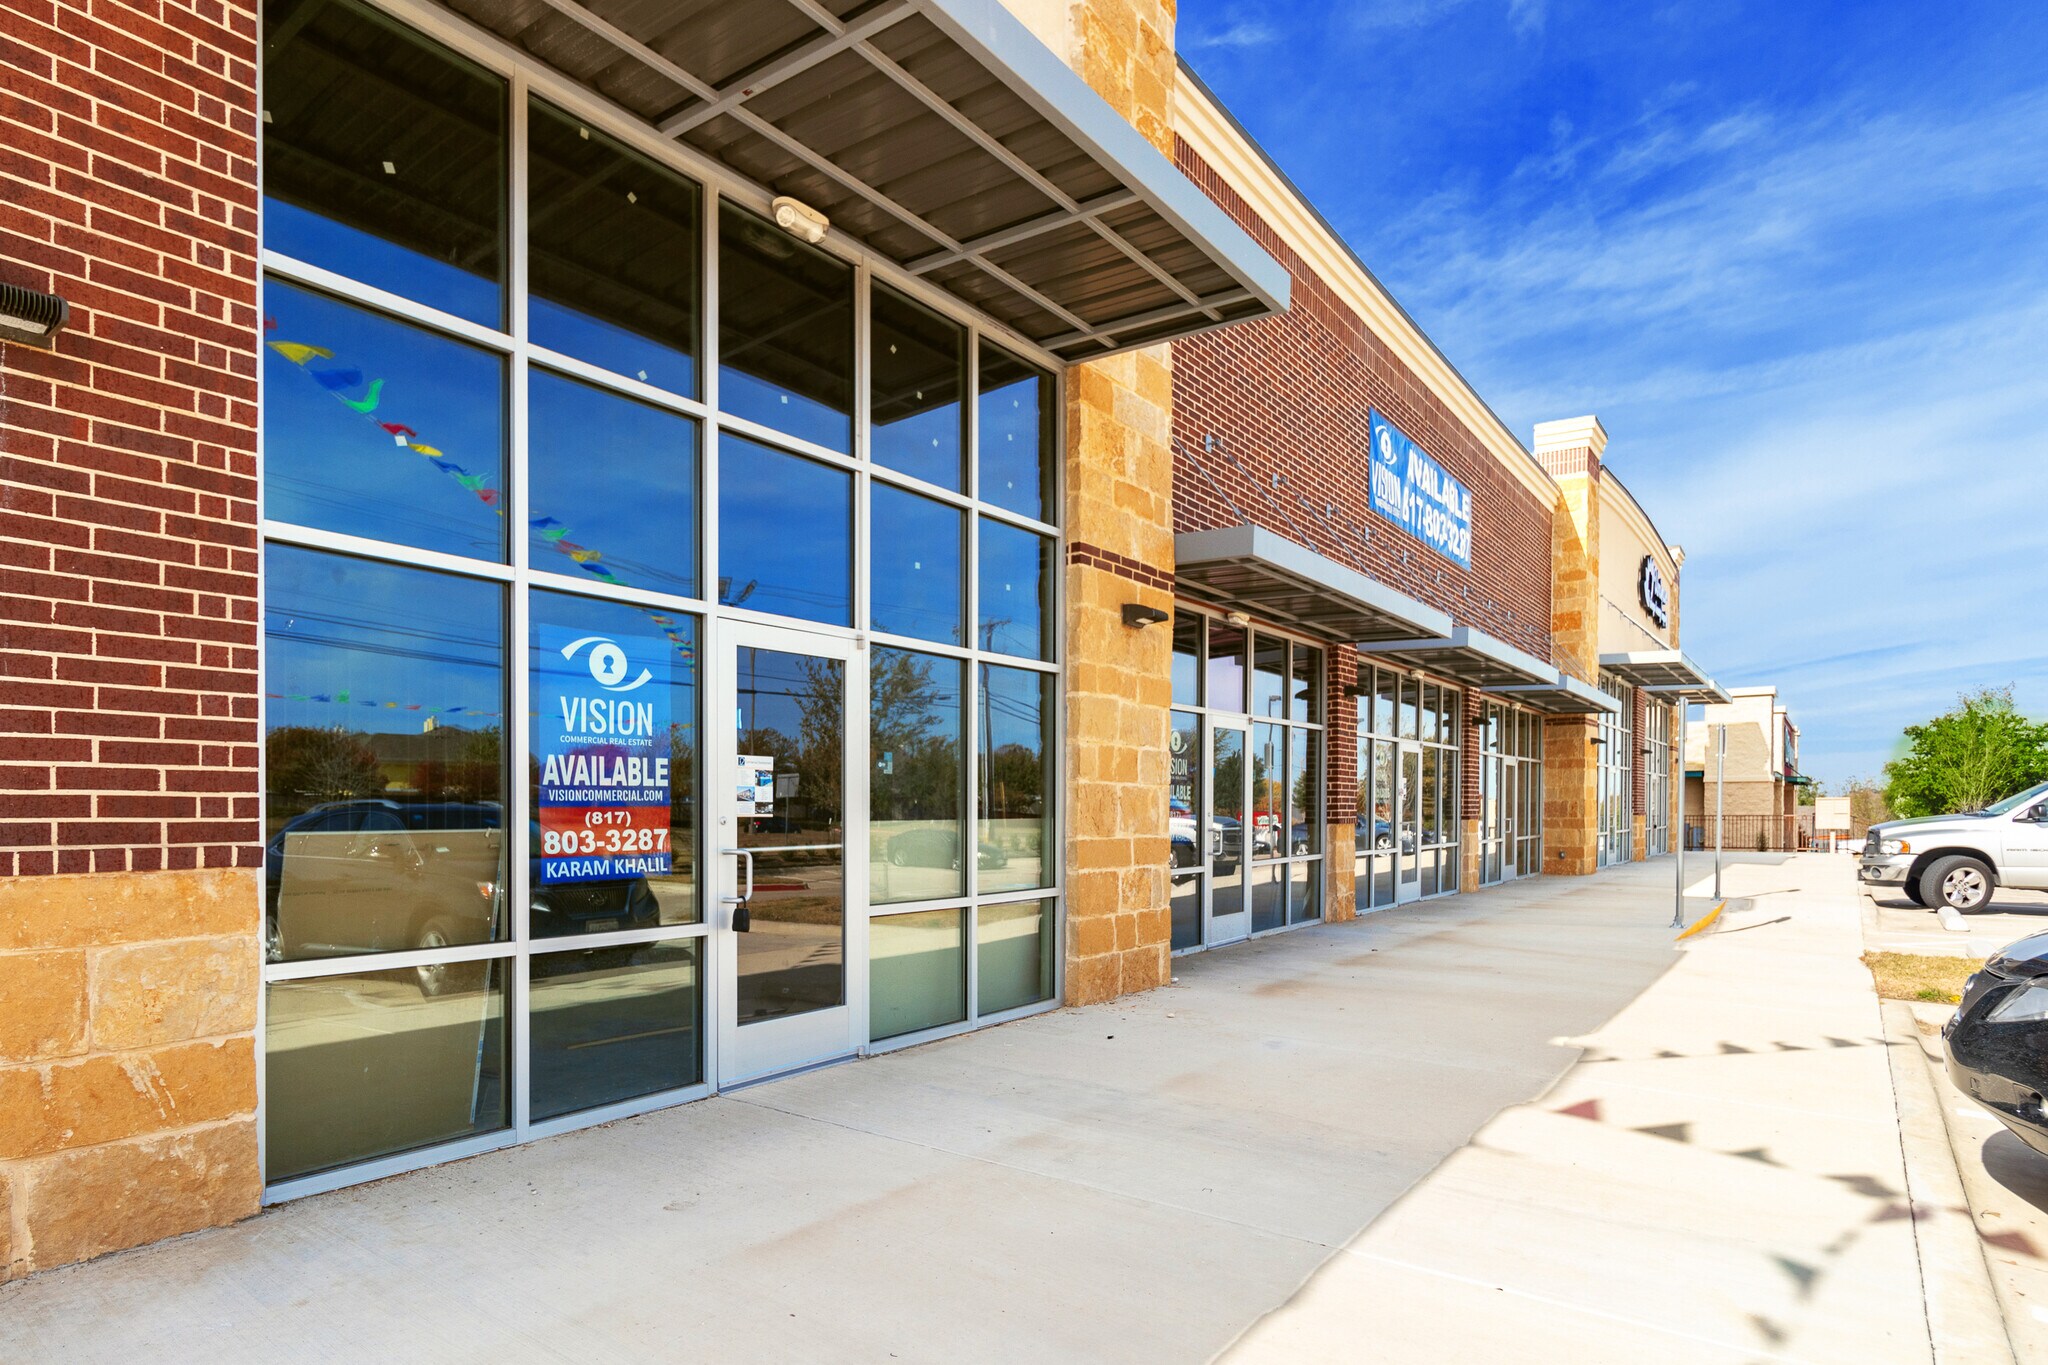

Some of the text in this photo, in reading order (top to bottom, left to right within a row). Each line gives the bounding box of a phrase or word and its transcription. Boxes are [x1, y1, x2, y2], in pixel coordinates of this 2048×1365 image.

[1372, 458, 1401, 509] VISION
[1407, 448, 1469, 523] AVAILABLE
[560, 696, 652, 736] VISION
[560, 735, 608, 745] COMMERCIAL
[628, 738, 652, 746] ESTATE
[542, 754, 668, 787] AVAILABLE
[1170, 757, 1187, 775] SION
[548, 789, 663, 801] VISIONCOMMERCIAL.COM
[1170, 784, 1191, 800] ILABLE
[585, 811, 631, 828] (817)
[544, 828, 668, 854] 803-3287
[546, 857, 668, 878] KARAM KHALIL
